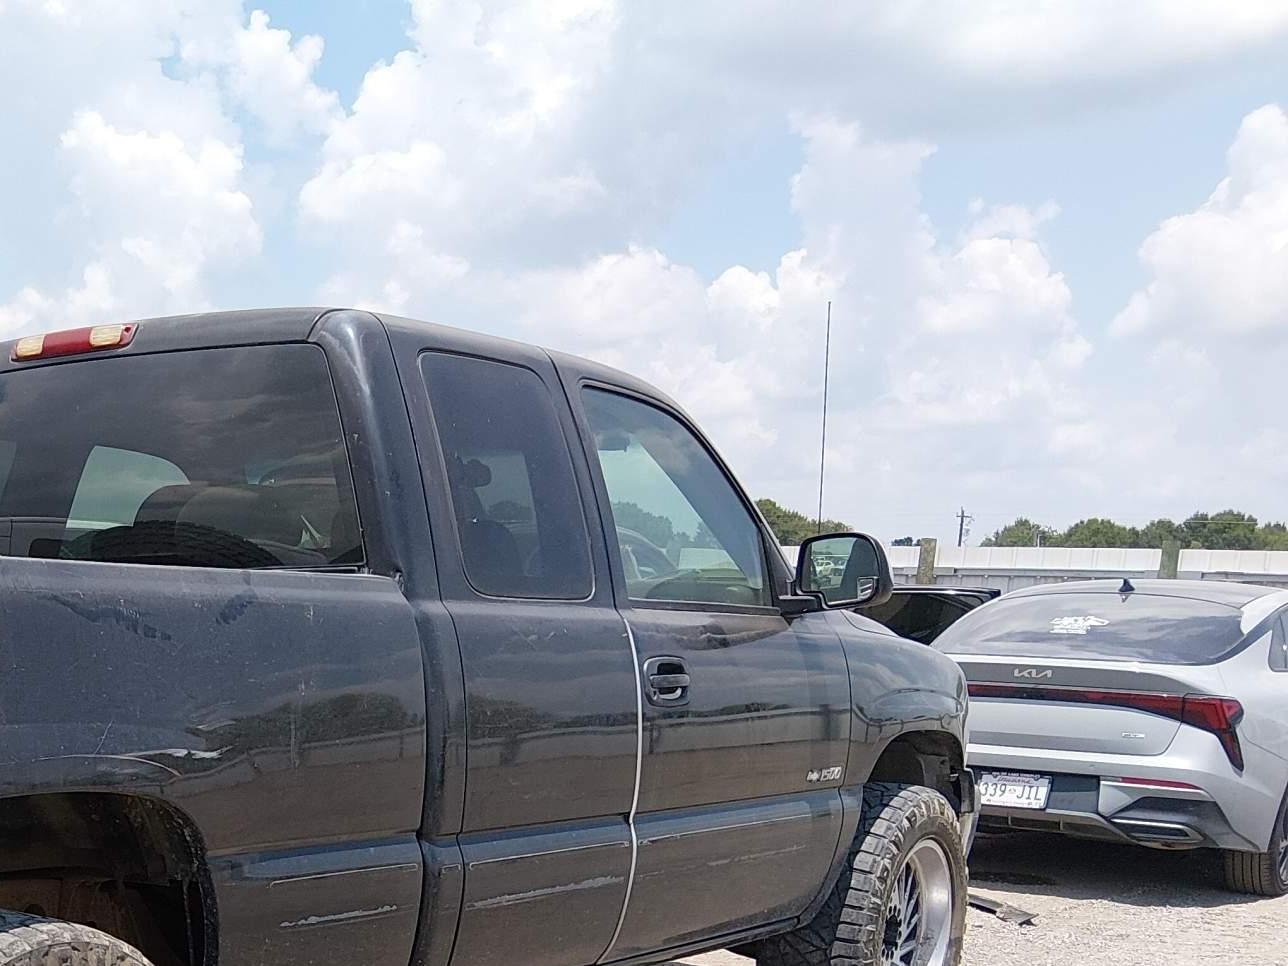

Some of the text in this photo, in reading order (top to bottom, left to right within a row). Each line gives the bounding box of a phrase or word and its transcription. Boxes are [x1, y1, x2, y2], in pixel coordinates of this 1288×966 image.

[1013, 668, 1053, 679] KIA
[820, 766, 842, 781] 1500
[980, 782, 1042, 801] 339 JIL
